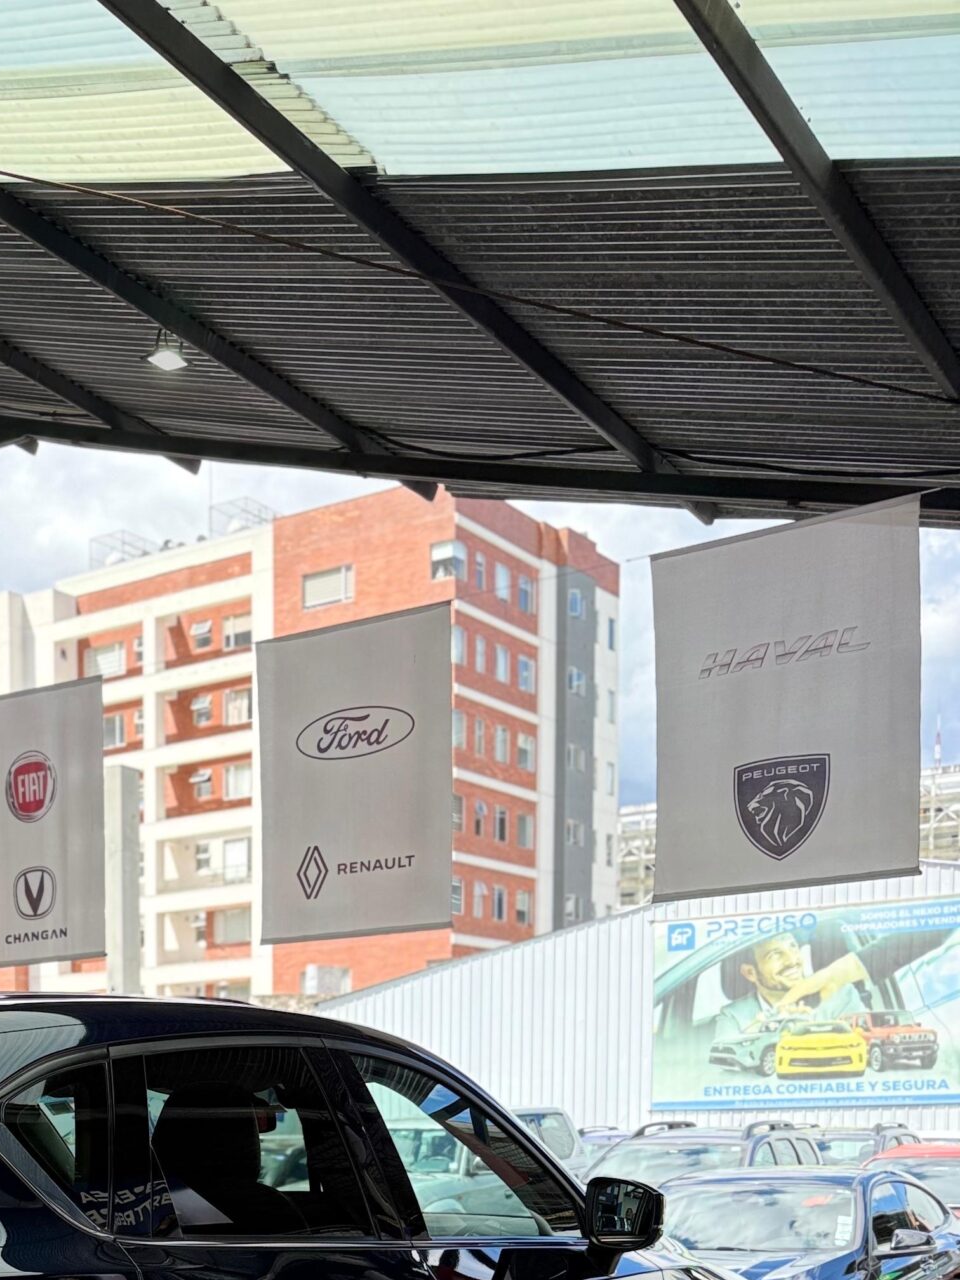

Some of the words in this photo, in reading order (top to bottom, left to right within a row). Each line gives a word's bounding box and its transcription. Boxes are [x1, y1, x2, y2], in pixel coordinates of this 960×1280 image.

[698, 626, 871, 680] HAVAL
[317, 713, 390, 754] Ford
[742, 762, 821, 782] PEUGEOT
[17, 770, 45, 804] FIAT
[337, 854, 416, 875] RENAULT
[5, 927, 68, 945] CHANGAN
[707, 913, 817, 938] PRECISO
[703, 1084, 772, 1097] ENTREGA
[776, 1082, 864, 1095] CONFIABLE
[868, 1081, 878, 1092] Y
[881, 1079, 949, 1092] SEGURA
